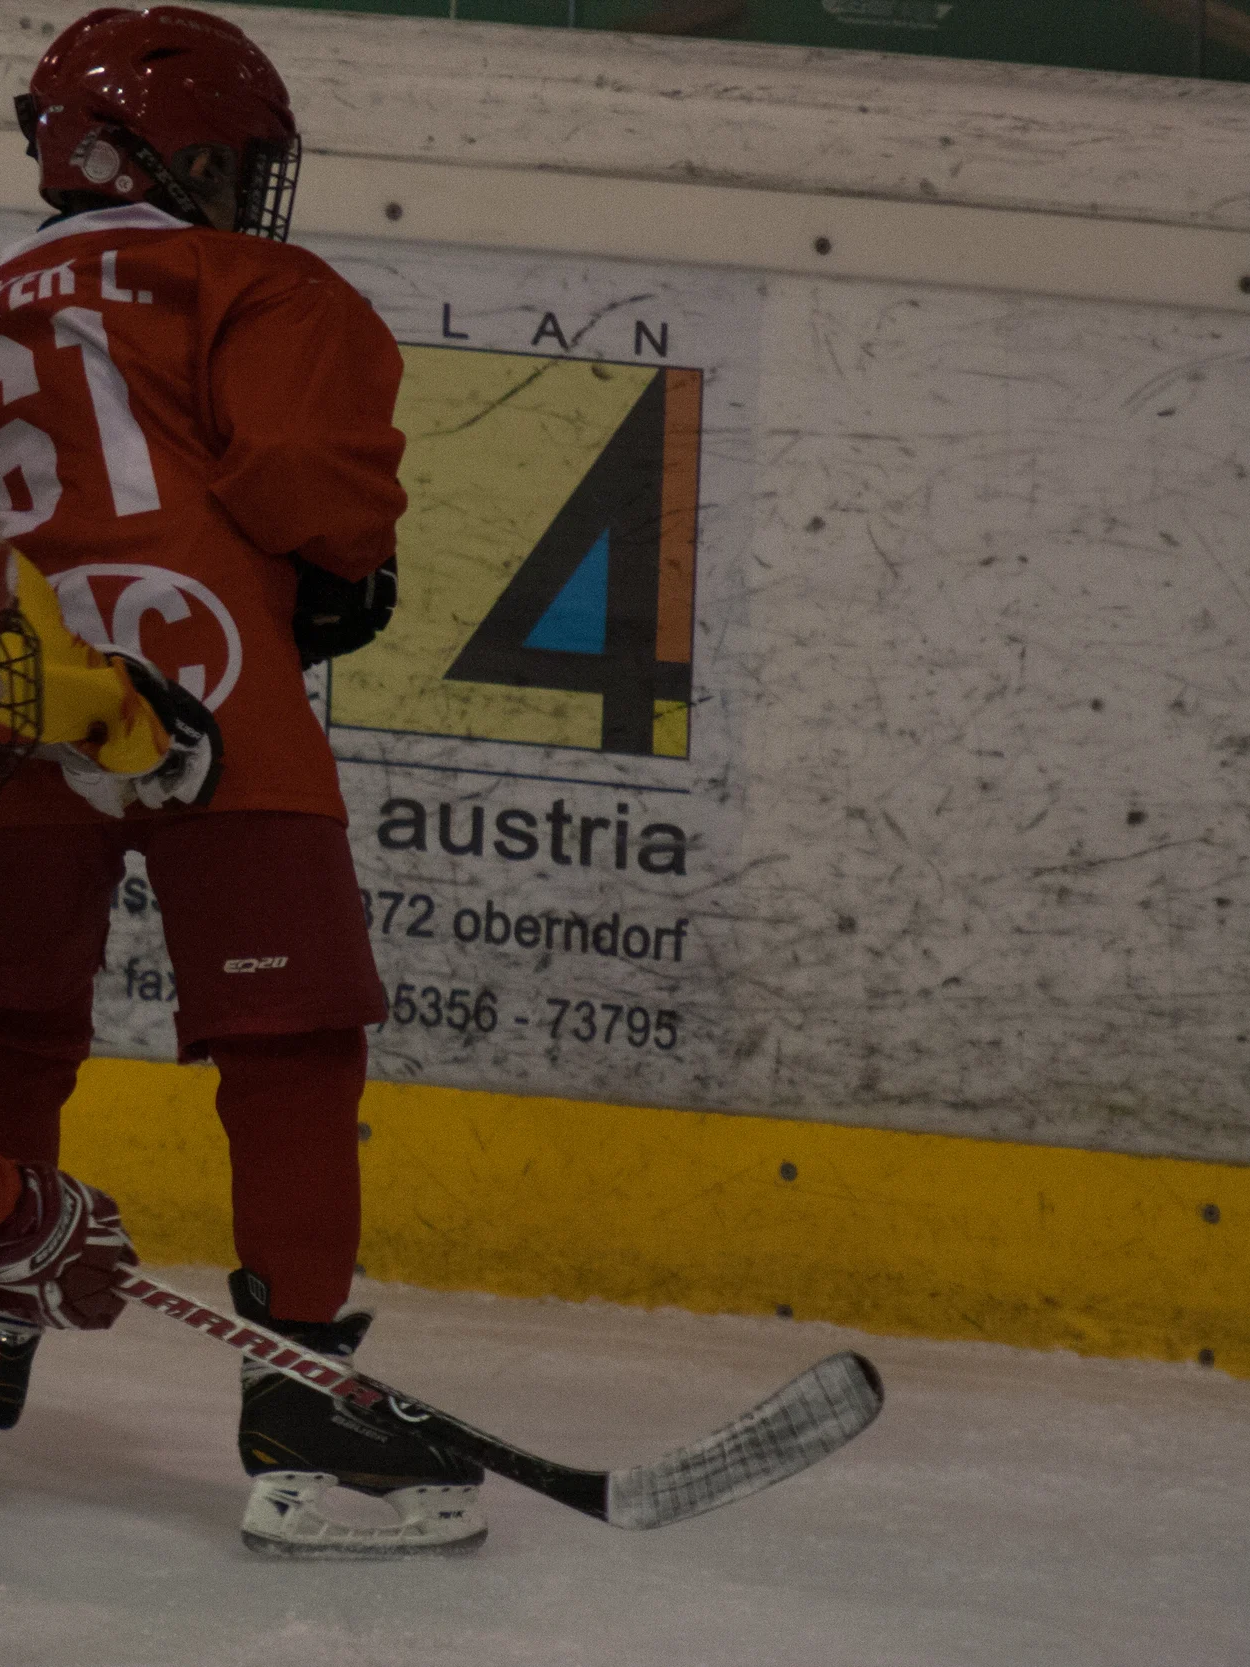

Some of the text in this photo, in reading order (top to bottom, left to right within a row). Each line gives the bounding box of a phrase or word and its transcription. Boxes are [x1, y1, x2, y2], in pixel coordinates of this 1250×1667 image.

[100, 249, 154, 305] L.
[376, 796, 690, 877] austria
[453, 899, 690, 963] oberndorf
[547, 998, 681, 1050] 73795
